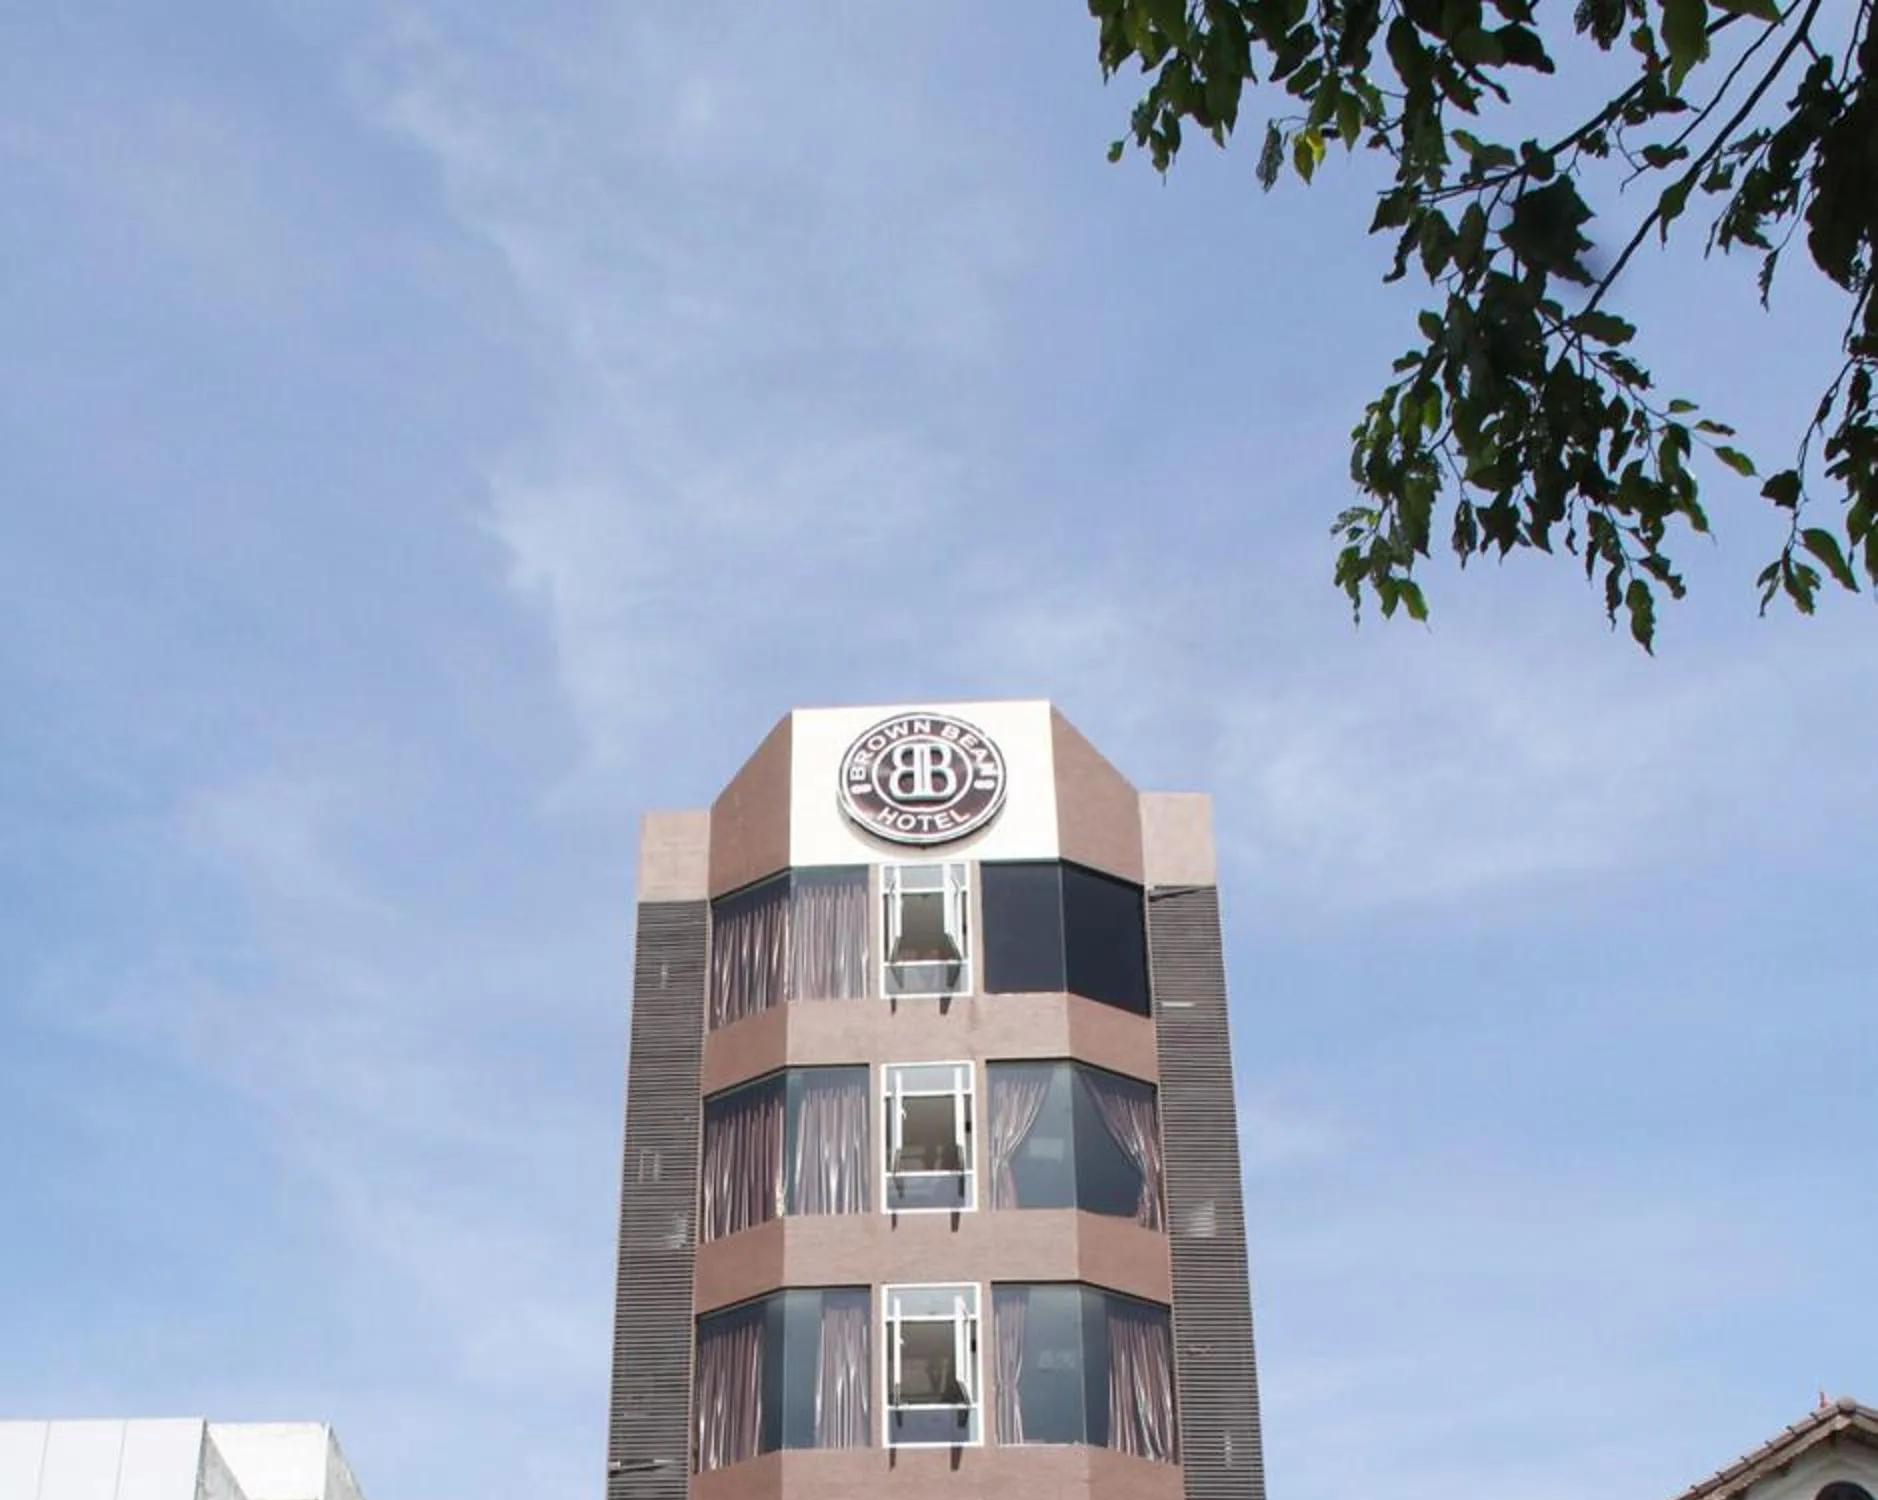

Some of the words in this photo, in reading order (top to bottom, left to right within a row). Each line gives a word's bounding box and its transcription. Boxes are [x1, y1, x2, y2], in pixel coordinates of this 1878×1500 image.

[850, 719, 932, 781] BROWN
[940, 723, 998, 778] BEAN
[876, 806, 971, 831] HOTEL
